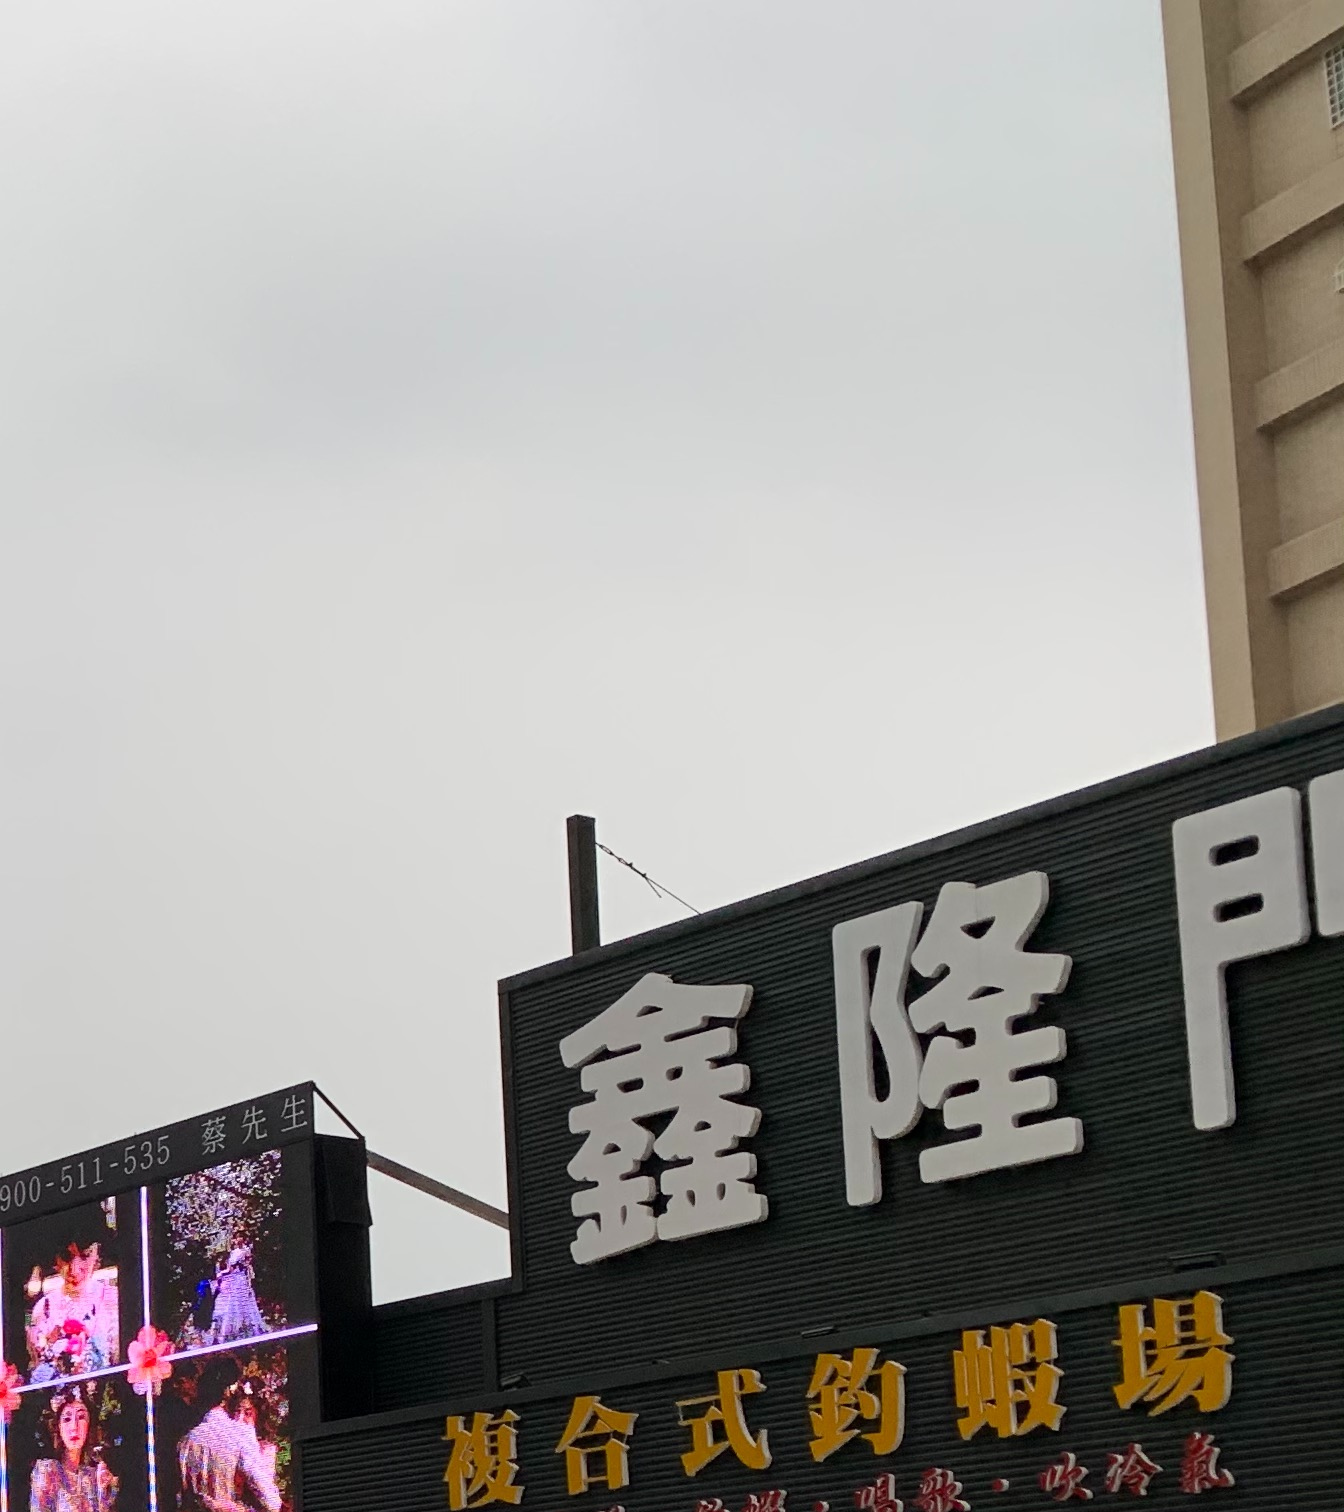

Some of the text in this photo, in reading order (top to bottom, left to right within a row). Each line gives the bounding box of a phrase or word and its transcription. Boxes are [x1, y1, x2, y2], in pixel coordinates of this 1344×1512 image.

[200, 1093, 309, 1157] 蔡先生
[442, 1290, 1235, 1511] 複合式釣蝦場
